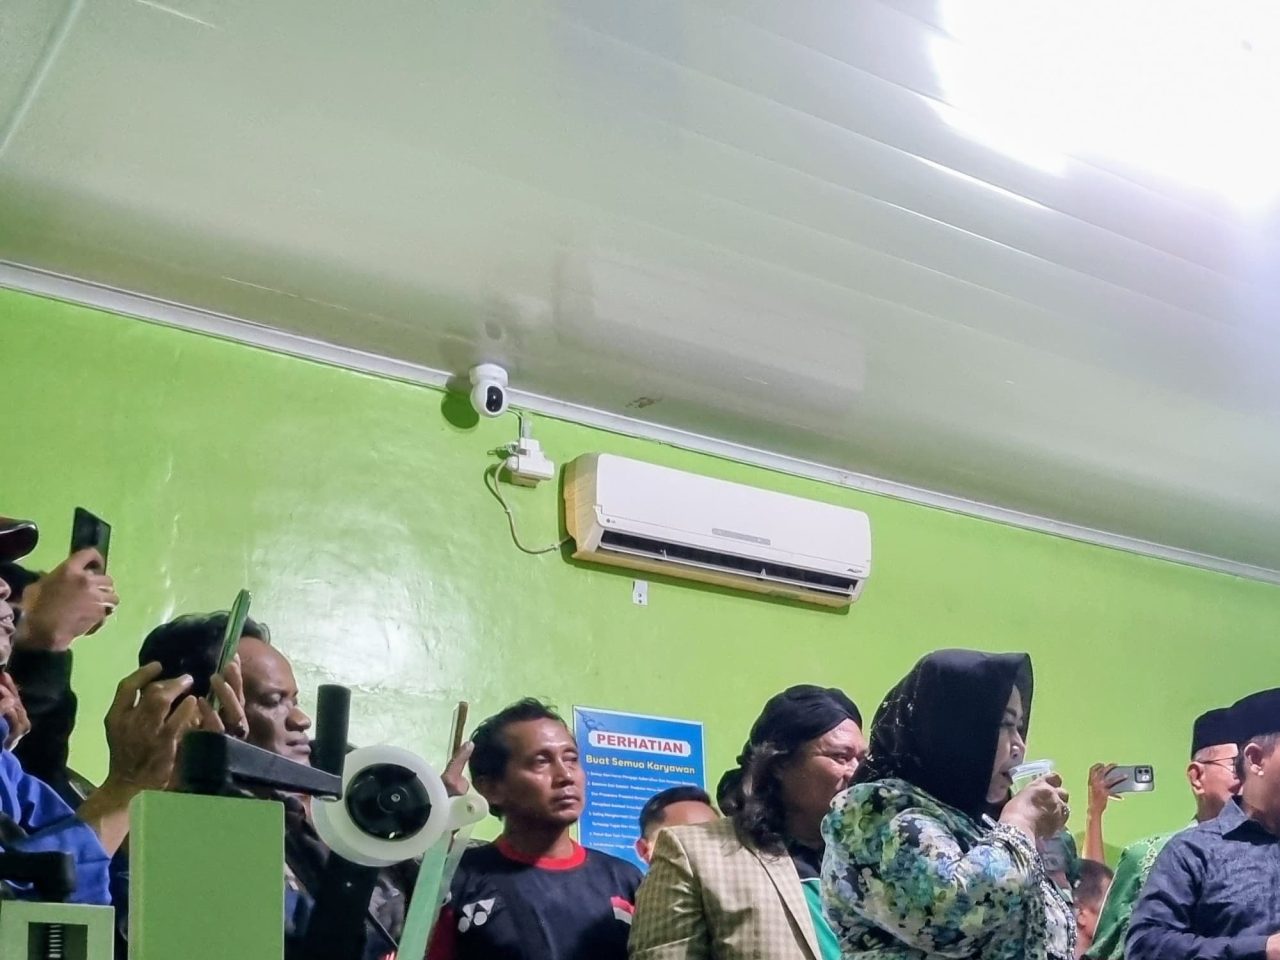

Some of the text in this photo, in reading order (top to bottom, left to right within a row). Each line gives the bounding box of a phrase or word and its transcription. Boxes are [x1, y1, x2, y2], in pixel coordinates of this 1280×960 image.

[596, 733, 684, 754] PERHATIAN
[586, 754, 695, 774] Buat Semua Karyawan
